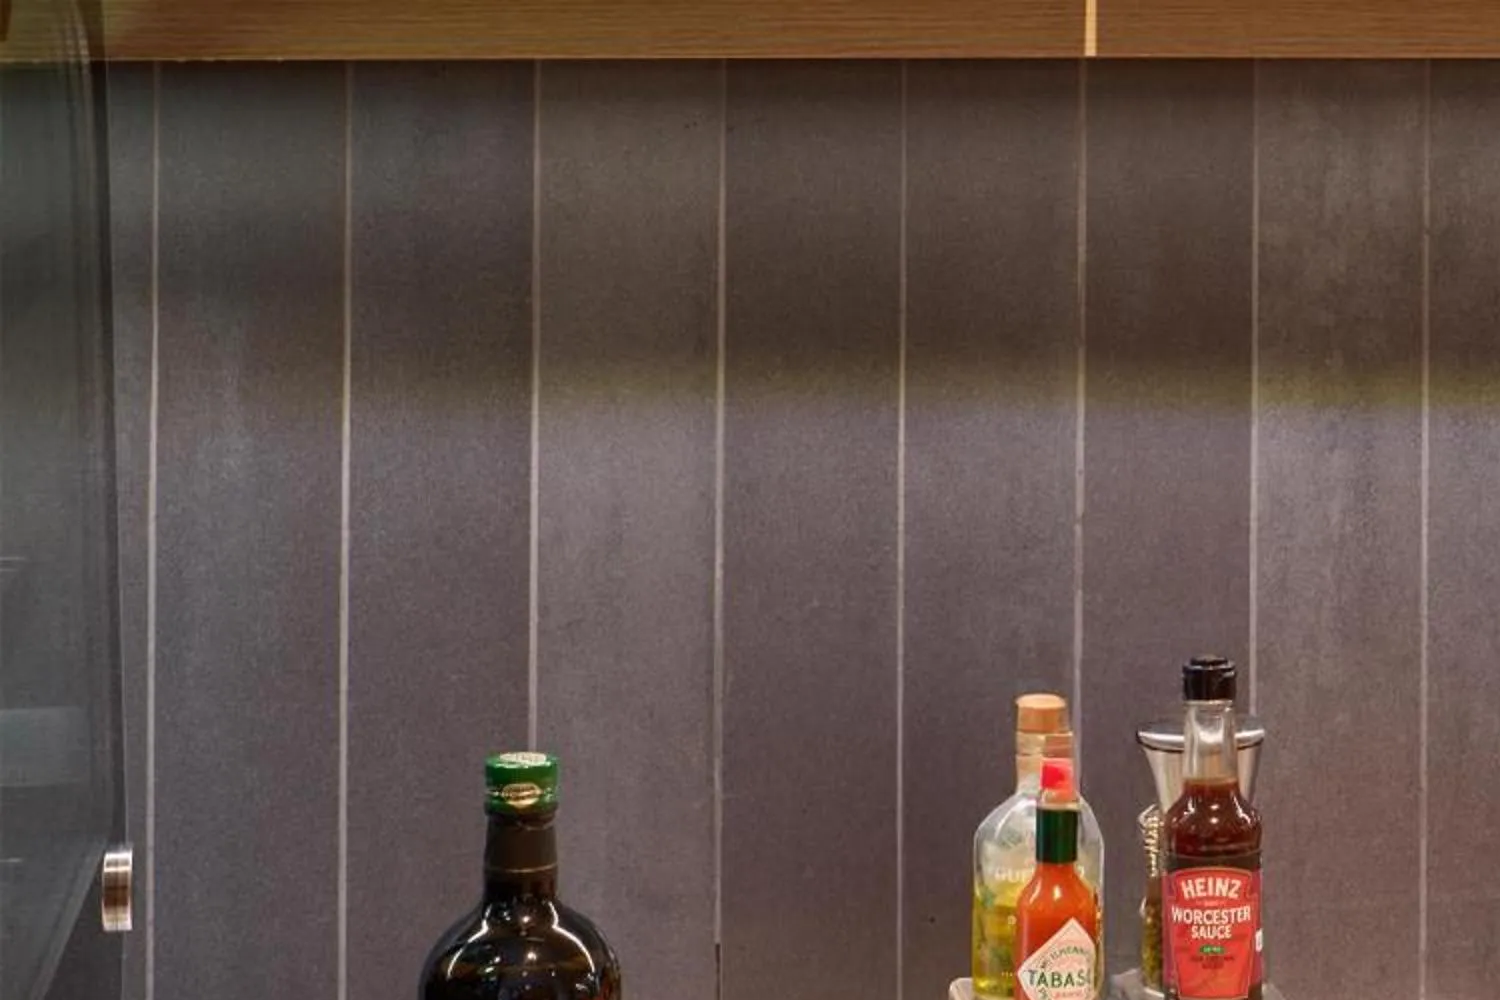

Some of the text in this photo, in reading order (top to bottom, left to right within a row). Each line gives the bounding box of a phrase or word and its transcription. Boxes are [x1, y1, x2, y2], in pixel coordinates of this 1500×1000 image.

[1181, 877, 1242, 899] HEINZ
[1171, 905, 1251, 925] WORCESTER
[1191, 925, 1232, 939] SAUCE
[1027, 968, 1091, 988] TABAS
